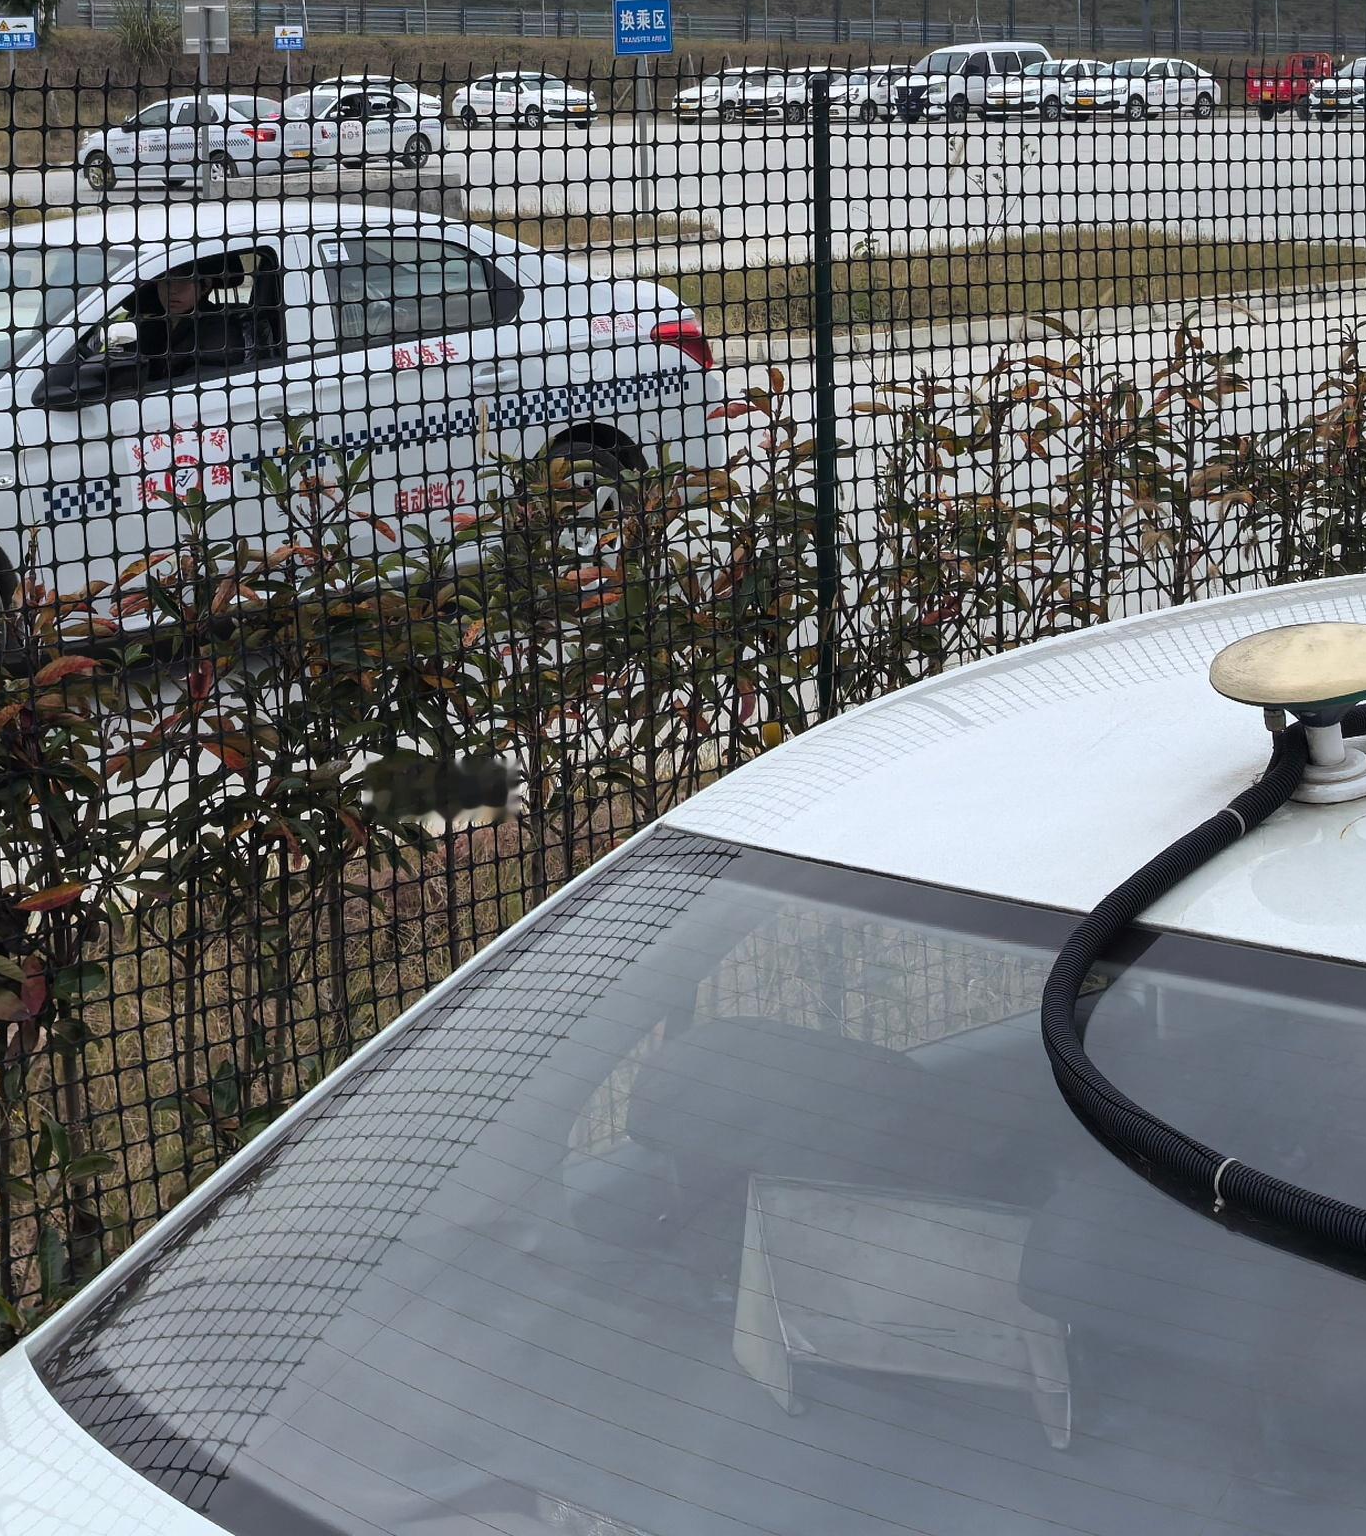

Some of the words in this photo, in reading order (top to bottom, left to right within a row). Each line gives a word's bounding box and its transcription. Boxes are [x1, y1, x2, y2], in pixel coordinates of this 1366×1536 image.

[620, 9, 666, 31] 换乘区
[391, 341, 459, 369] 教练车
